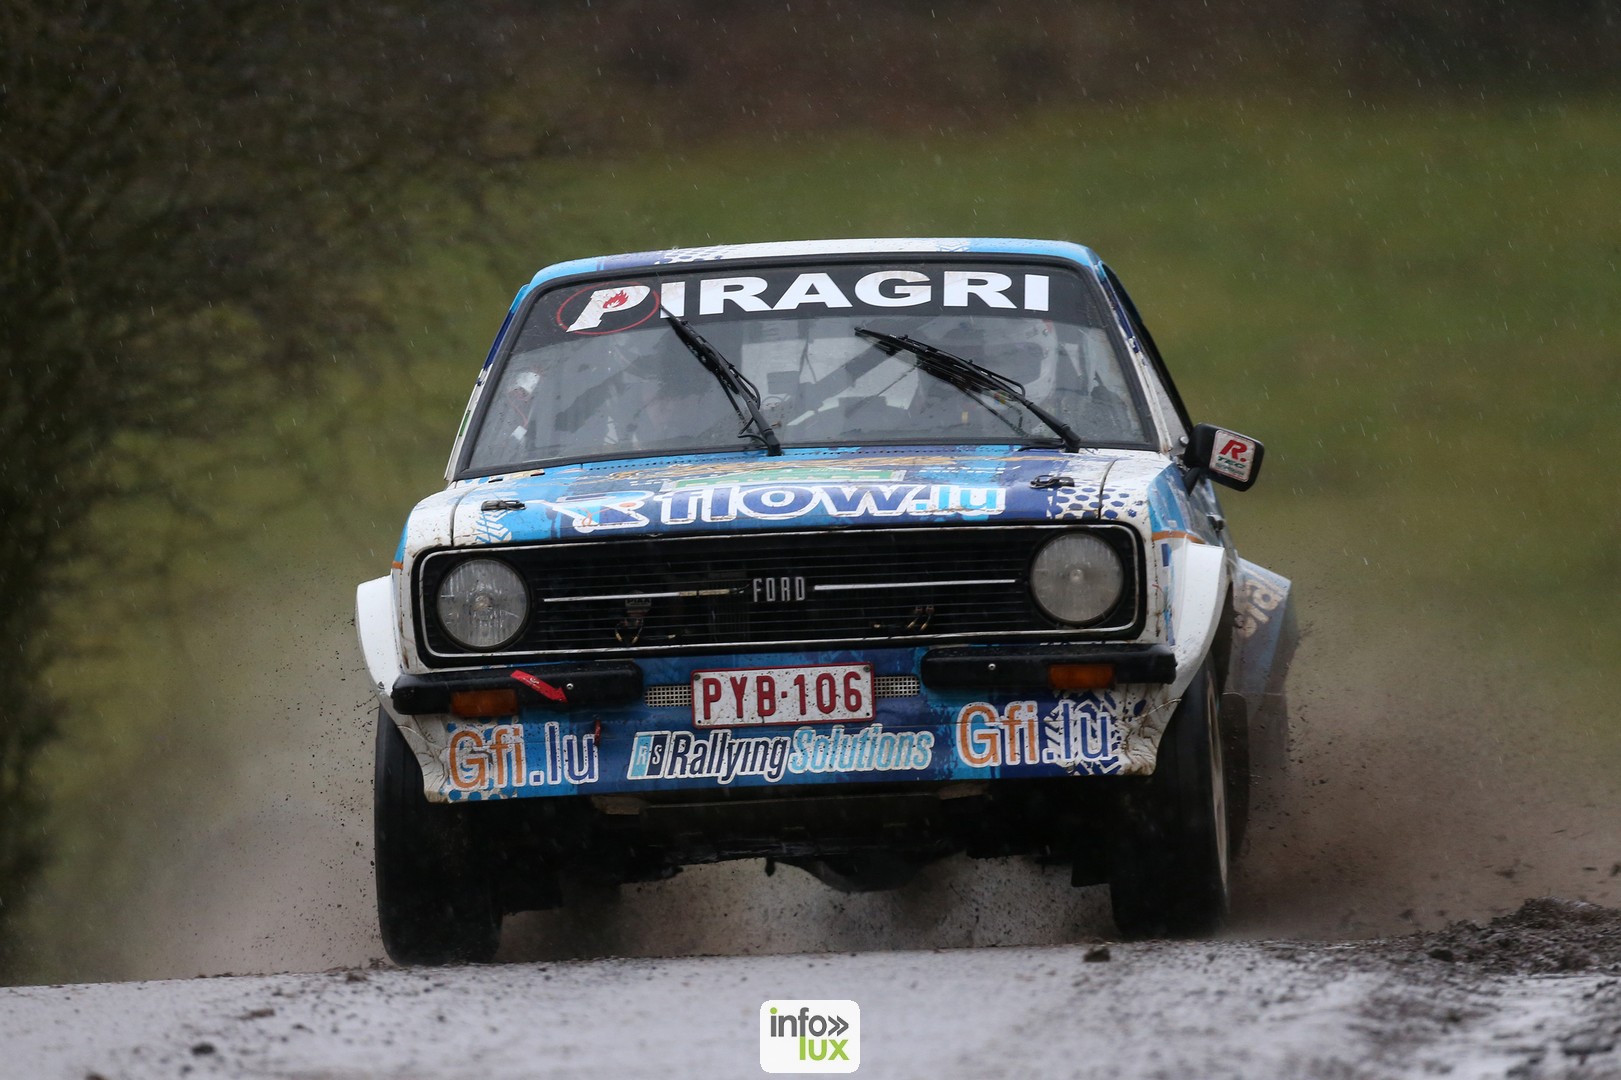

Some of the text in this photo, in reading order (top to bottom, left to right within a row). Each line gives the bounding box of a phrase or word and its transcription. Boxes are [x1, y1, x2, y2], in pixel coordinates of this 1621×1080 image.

[565, 270, 1050, 333] PIRAGRI
[752, 576, 806, 603] FORD
[449, 722, 599, 791] Gfi.lu
[667, 730, 789, 782] Rallying
[790, 725, 934, 772] Solutions
[957, 701, 1113, 766] Gfi.lu
